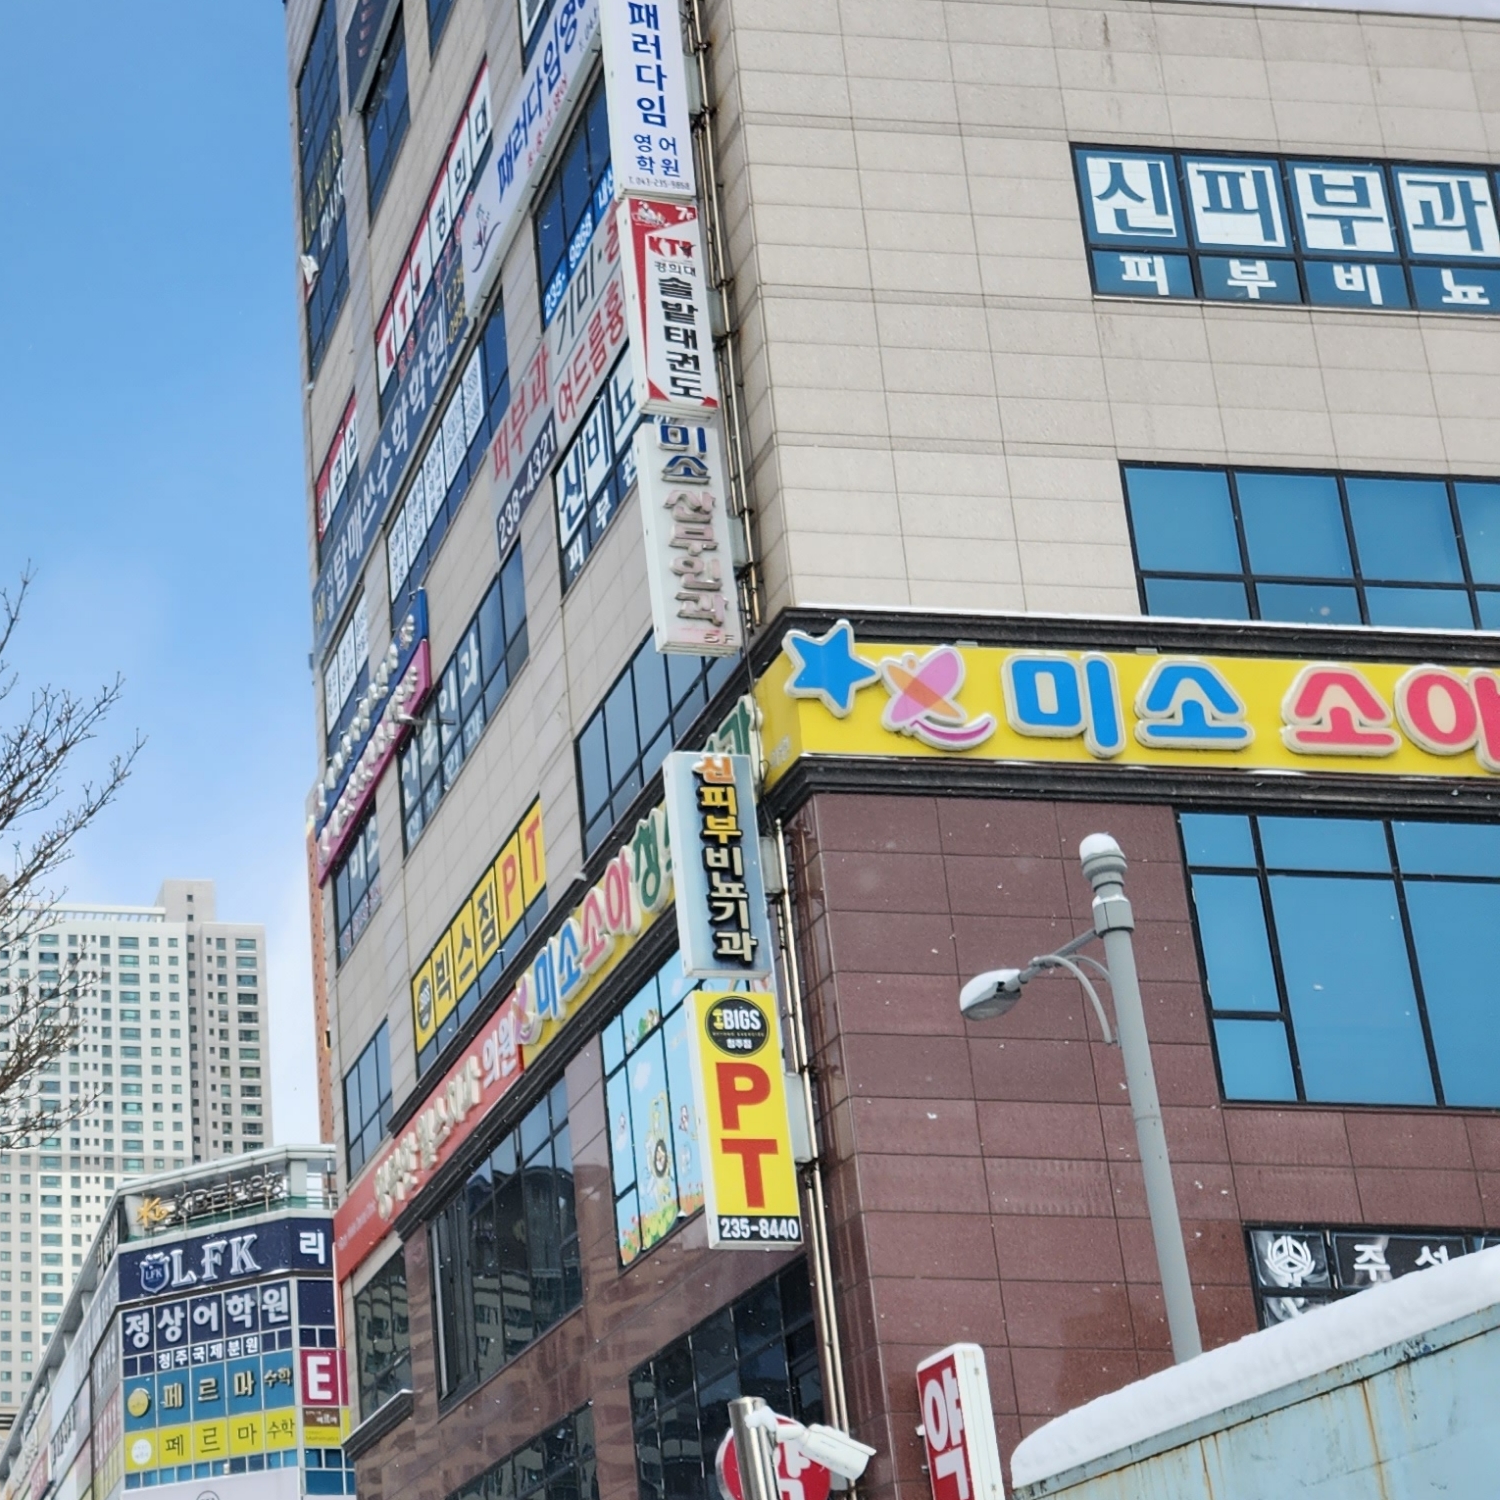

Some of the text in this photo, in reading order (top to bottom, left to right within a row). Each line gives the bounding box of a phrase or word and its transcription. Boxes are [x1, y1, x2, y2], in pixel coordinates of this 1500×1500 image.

[628, 1, 668, 128] 패러다임
[1094, 160, 1488, 254] 신피부과
[655, 261, 697, 278] 경희대
[1120, 254, 1490, 305] 피부비뇨
[658, 277, 703, 401] 솔밭태권도
[704, 633, 735, 644] 5F
[1003, 652, 1254, 758] 미소
[694, 754, 759, 966] 신피부비뇨기과
[723, 1008, 762, 1031] BIGS
[715, 1061, 779, 1209] PT
[720, 1216, 799, 1241] 235-8440
[171, 1233, 262, 1288] LFK
[125, 1286, 291, 1350] 정상어학원
[163, 1370, 256, 1410] 페르마
[165, 1417, 297, 1457] 페르마 수학
